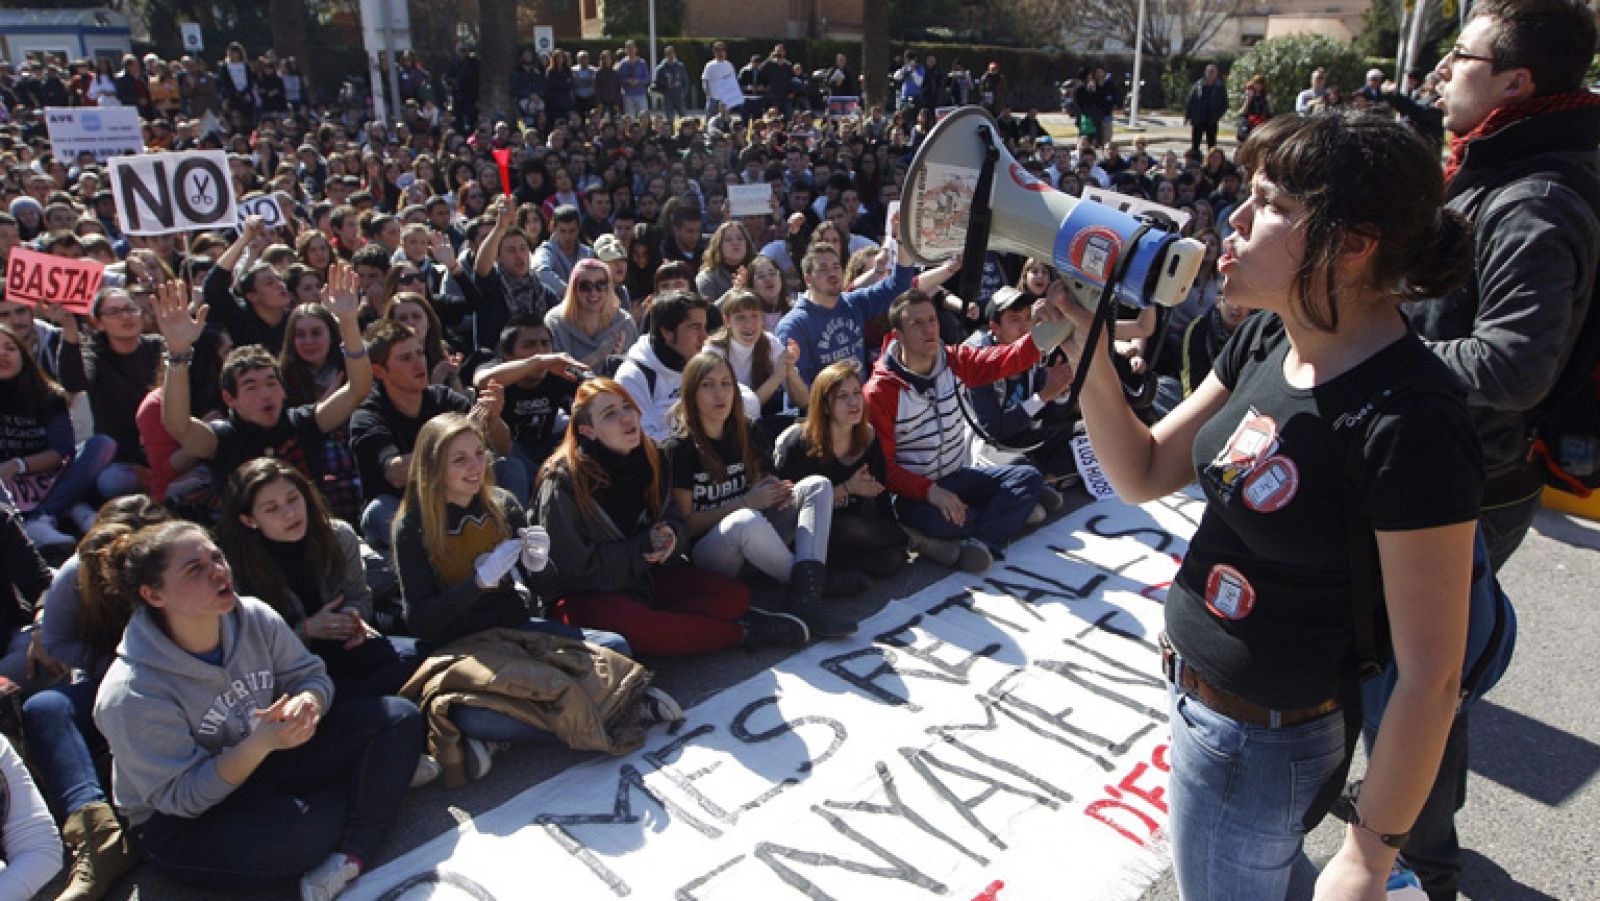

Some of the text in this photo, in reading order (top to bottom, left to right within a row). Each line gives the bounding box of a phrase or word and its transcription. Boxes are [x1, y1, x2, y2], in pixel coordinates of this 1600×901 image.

[116, 156, 230, 230] NO
[9, 258, 100, 300] BASTA!
[819, 514, 1173, 712] RETALLS
